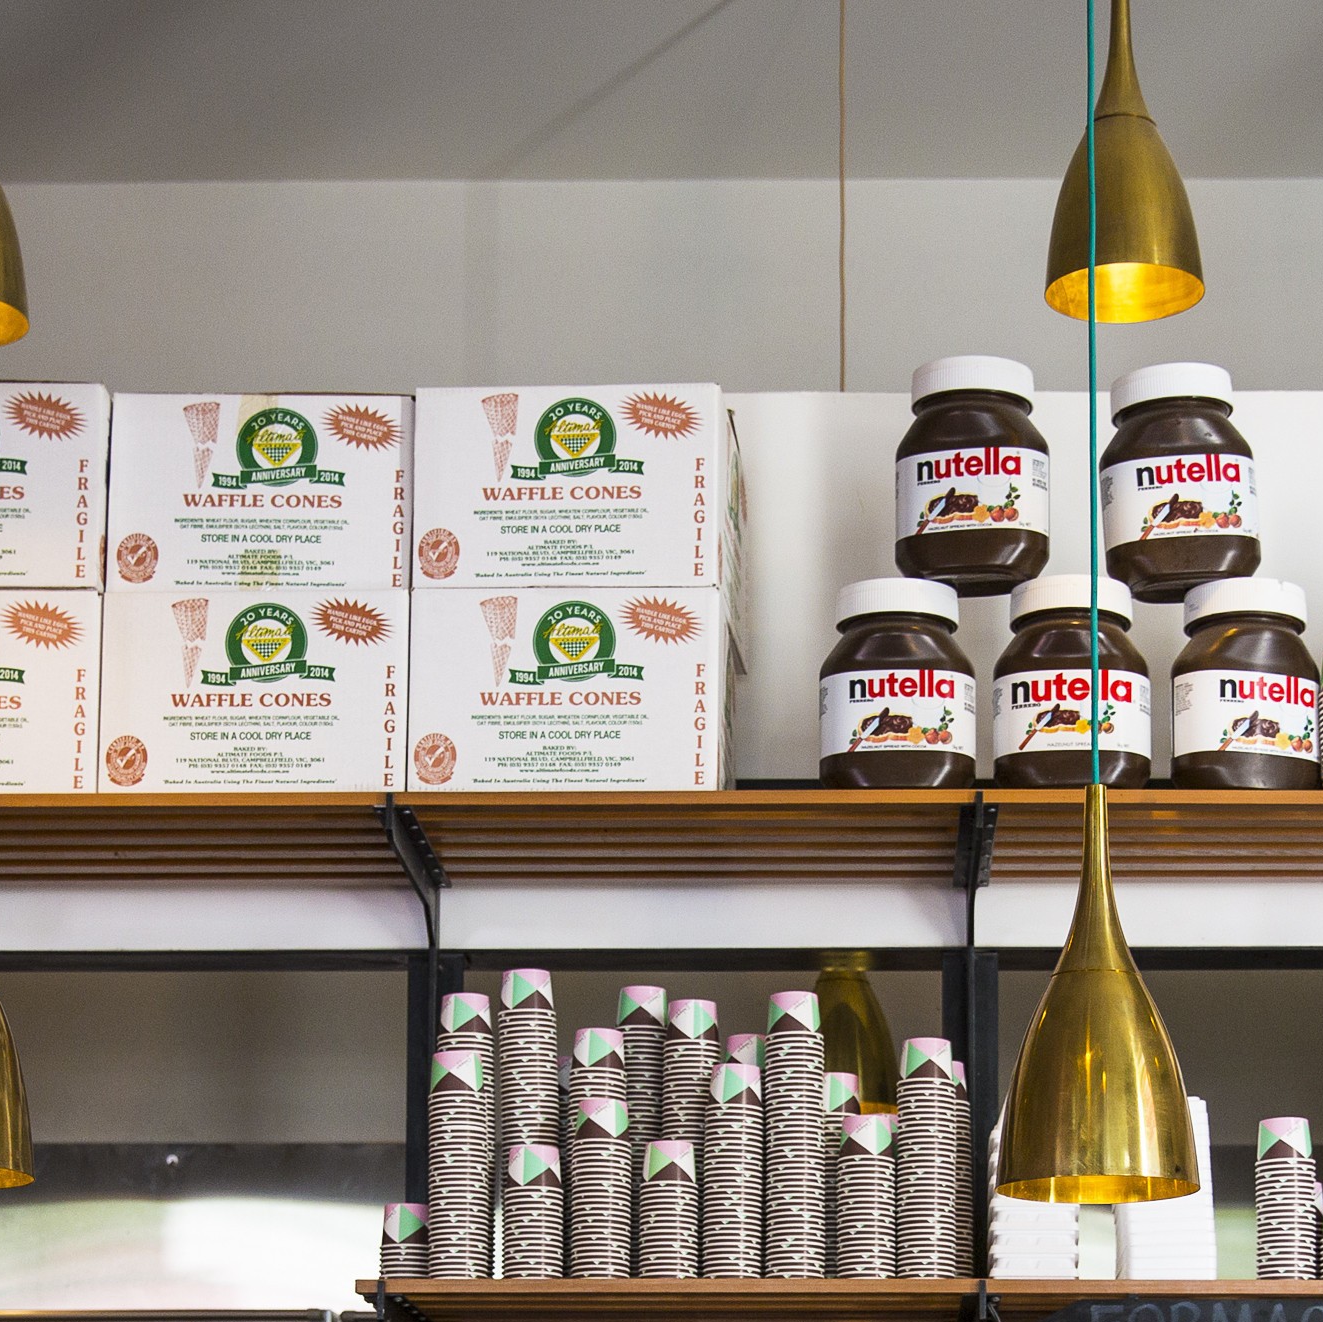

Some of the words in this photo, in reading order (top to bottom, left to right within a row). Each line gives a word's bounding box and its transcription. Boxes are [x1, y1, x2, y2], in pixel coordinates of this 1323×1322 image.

[251, 417, 266, 429] 20
[269, 413, 304, 430] YEARS
[549, 408, 564, 419] 20
[568, 404, 602, 419] YEARS
[2, 461, 21, 470] 2014
[517, 468, 535, 478] 1994
[550, 457, 605, 472] ANNIVERSARY
[619, 462, 638, 470] 2014
[917, 446, 1021, 481] nutella
[1136, 454, 1241, 487] nutella
[218, 476, 236, 486] 1994
[251, 466, 306, 483] ANNIVERSARY
[320, 473, 339, 482] 2014
[182, 494, 264, 508] WAFFLE
[270, 495, 343, 508] CONES
[482, 486, 563, 501] WAFFLE
[569, 486, 641, 499] CONES
[74, 460, 89, 578] FRAGILE
[694, 458, 705, 577] FRAGILE
[201, 534, 228, 542] STORE
[249, 534, 273, 543] COOL
[276, 535, 292, 543] DRY
[295, 535, 322, 543] PLACE
[392, 469, 405, 588] FRAGILE
[501, 526, 528, 534] STORE
[549, 525, 572, 533] COOL
[576, 525, 591, 533] DRY
[594, 524, 621, 532] PLACE
[240, 612, 255, 624] 20
[259, 608, 293, 625] YEARS
[548, 610, 563, 623] 20
[566, 607, 601, 623] YEARS
[0, 670, 18, 680] 2014
[207, 673, 225, 684] 1994
[240, 662, 296, 678] ANNIVERSARY
[310, 668, 328, 677] 2014
[515, 672, 534, 682] 1994
[549, 661, 605, 677] ANNIVERSARY
[619, 667, 637, 676] 2014
[849, 669, 955, 700] nutella
[1012, 669, 1133, 704] nutela
[1220, 676, 1315, 709] nutella
[171, 694, 253, 707] WAFFLE
[259, 693, 332, 706] CONES
[479, 692, 562, 706] WAFFLE
[568, 692, 641, 705] CONES
[73, 669, 87, 789] FRAGILE
[383, 665, 396, 785] FRAGILE
[694, 664, 706, 785] FRAGILE
[190, 732, 218, 740] STORE
[221, 732, 229, 740] IN
[239, 732, 262, 740] COOL
[266, 732, 281, 740] DRY
[285, 732, 311, 740] PLACE
[499, 731, 526, 739] STORE
[548, 731, 571, 739] COOL
[575, 731, 591, 739] DRY
[594, 731, 621, 739] PLACE
